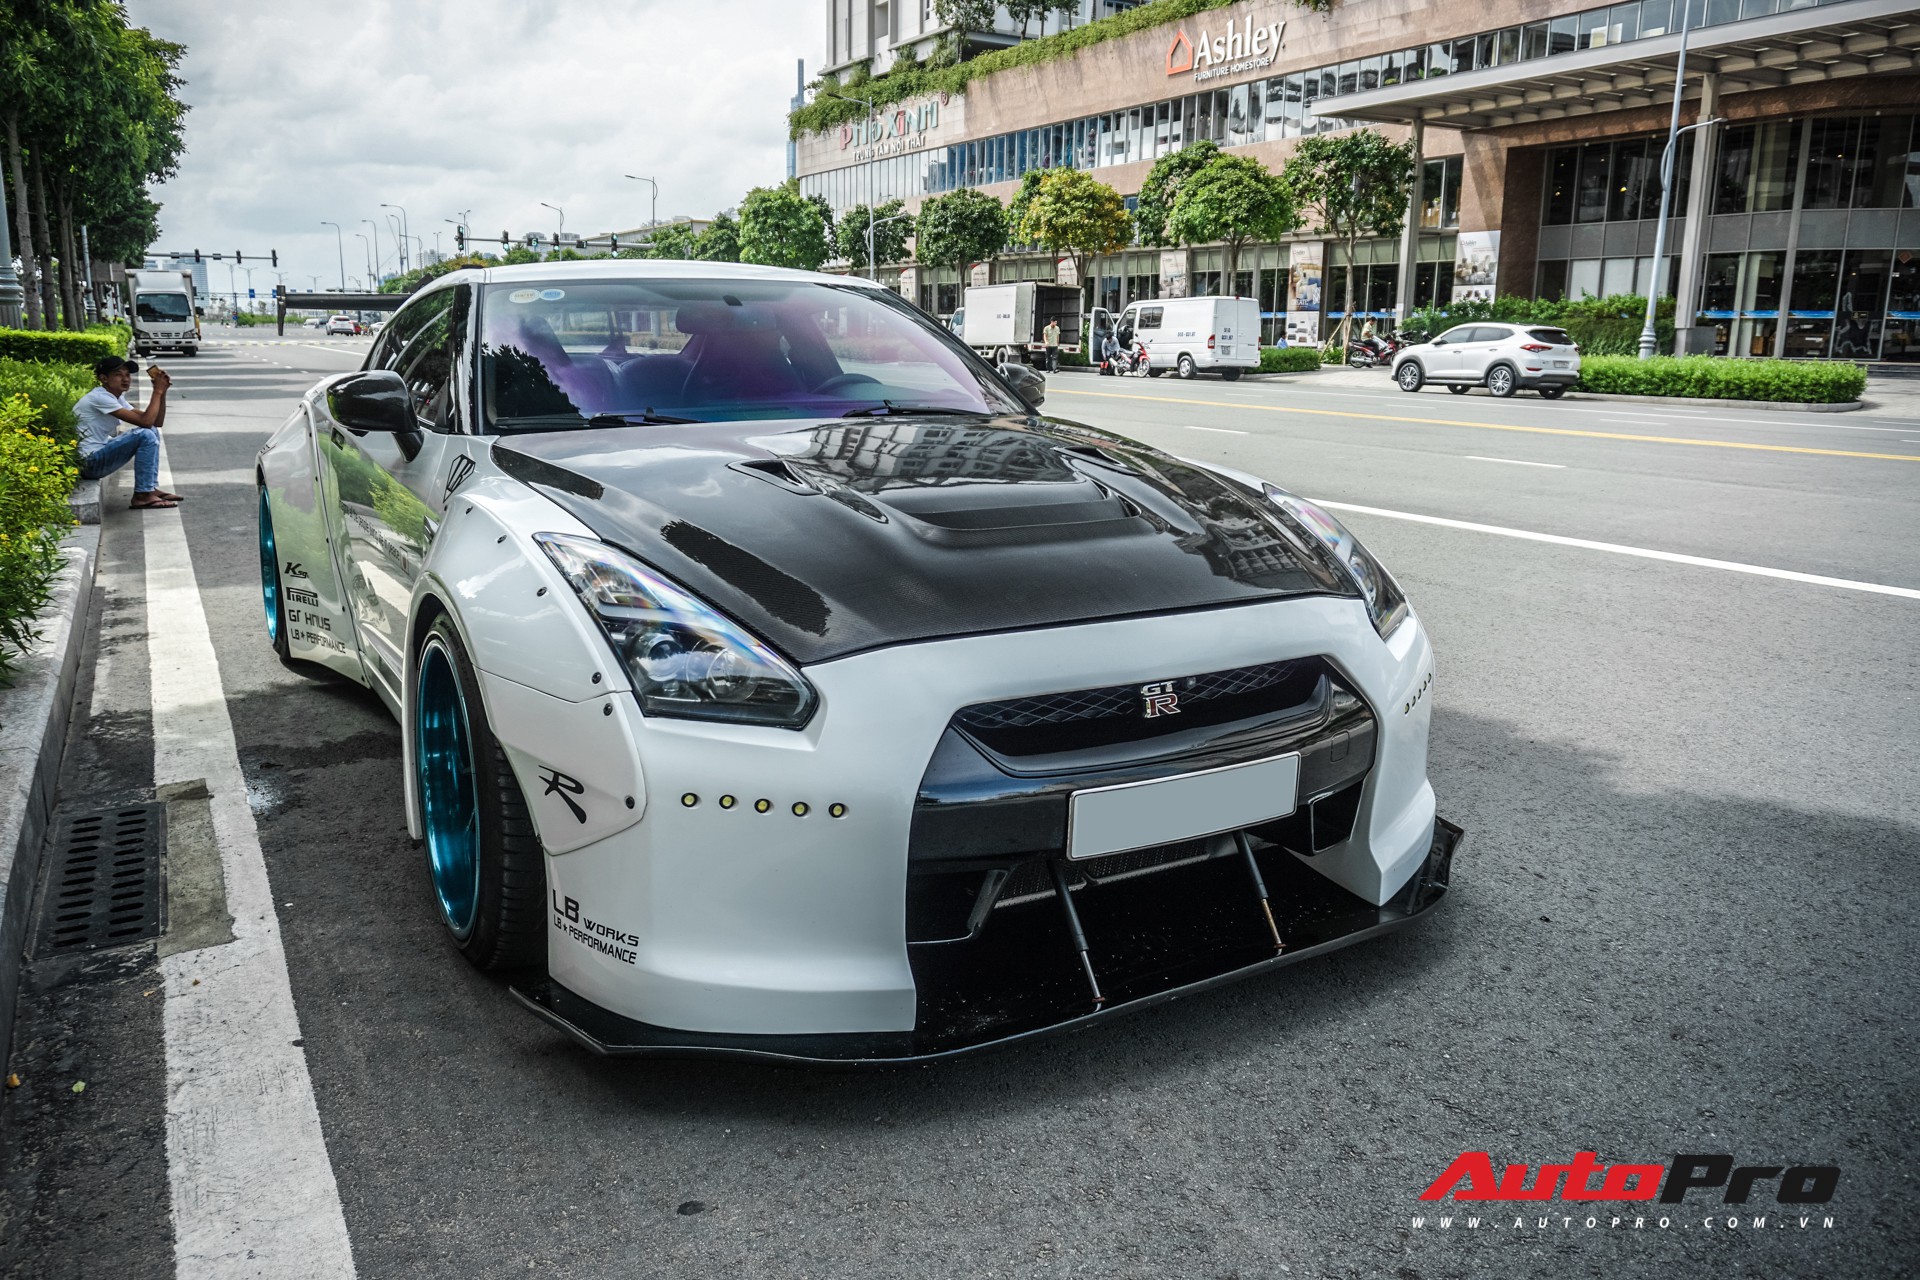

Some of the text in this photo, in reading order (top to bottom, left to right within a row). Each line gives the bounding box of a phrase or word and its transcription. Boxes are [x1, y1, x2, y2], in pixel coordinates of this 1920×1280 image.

[1194, 15, 1286, 69] Ashley
[1194, 56, 1271, 80] FURNITURE HOMESTORE
[286, 586, 319, 607] PIRELLI
[290, 628, 346, 654] LB PERFORMANCE
[1143, 693, 1181, 718] R
[552, 889, 640, 947] LB WORKS
[553, 913, 638, 965] LB PERFORMANCE
